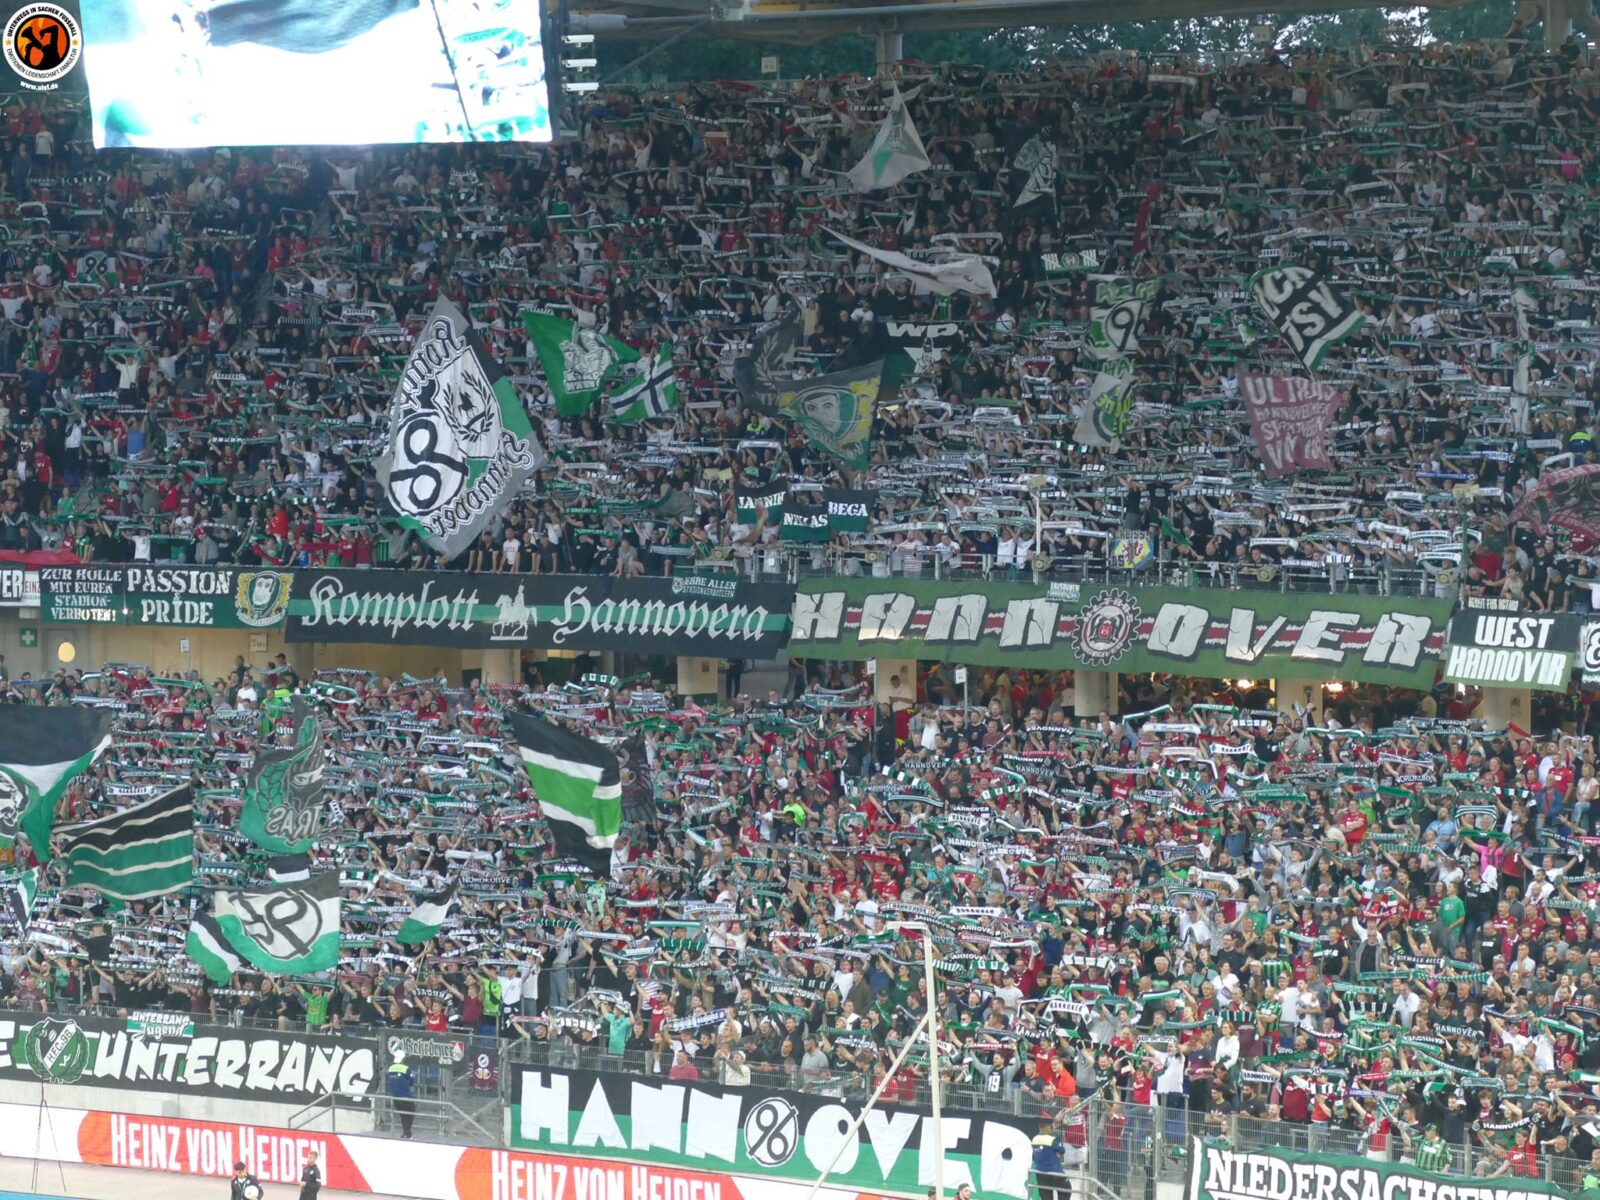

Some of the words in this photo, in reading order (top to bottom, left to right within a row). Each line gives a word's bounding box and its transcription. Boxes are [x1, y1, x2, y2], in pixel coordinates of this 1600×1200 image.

[828, 501, 868, 517] BEGA
[42, 568, 72, 580] ZUR
[127, 568, 233, 594] PASSION
[50, 582, 72, 593] MIT
[75, 582, 113, 594] EUREN
[685, 576, 707, 586] EHRE
[708, 579, 737, 590] ALLEN
[55, 595, 111, 607] STADION-
[51, 607, 116, 621] VERBOTEN!
[141, 599, 214, 625] PRIDE
[301, 575, 479, 639] Komplott
[550, 586, 769, 644] Hannovera
[1475, 615, 1555, 648] WEST
[132, 1010, 191, 1025] UNTERRANG
[1434, 1024, 1478, 1037] HANNOVER
[93, 1030, 374, 1102] UNTERRANG
[1482, 1117, 1531, 1130] HANNOVER
[111, 1114, 181, 1171] HEINZ
[186, 1127, 232, 1176] VON
[492, 1151, 567, 1200] HEINZ
